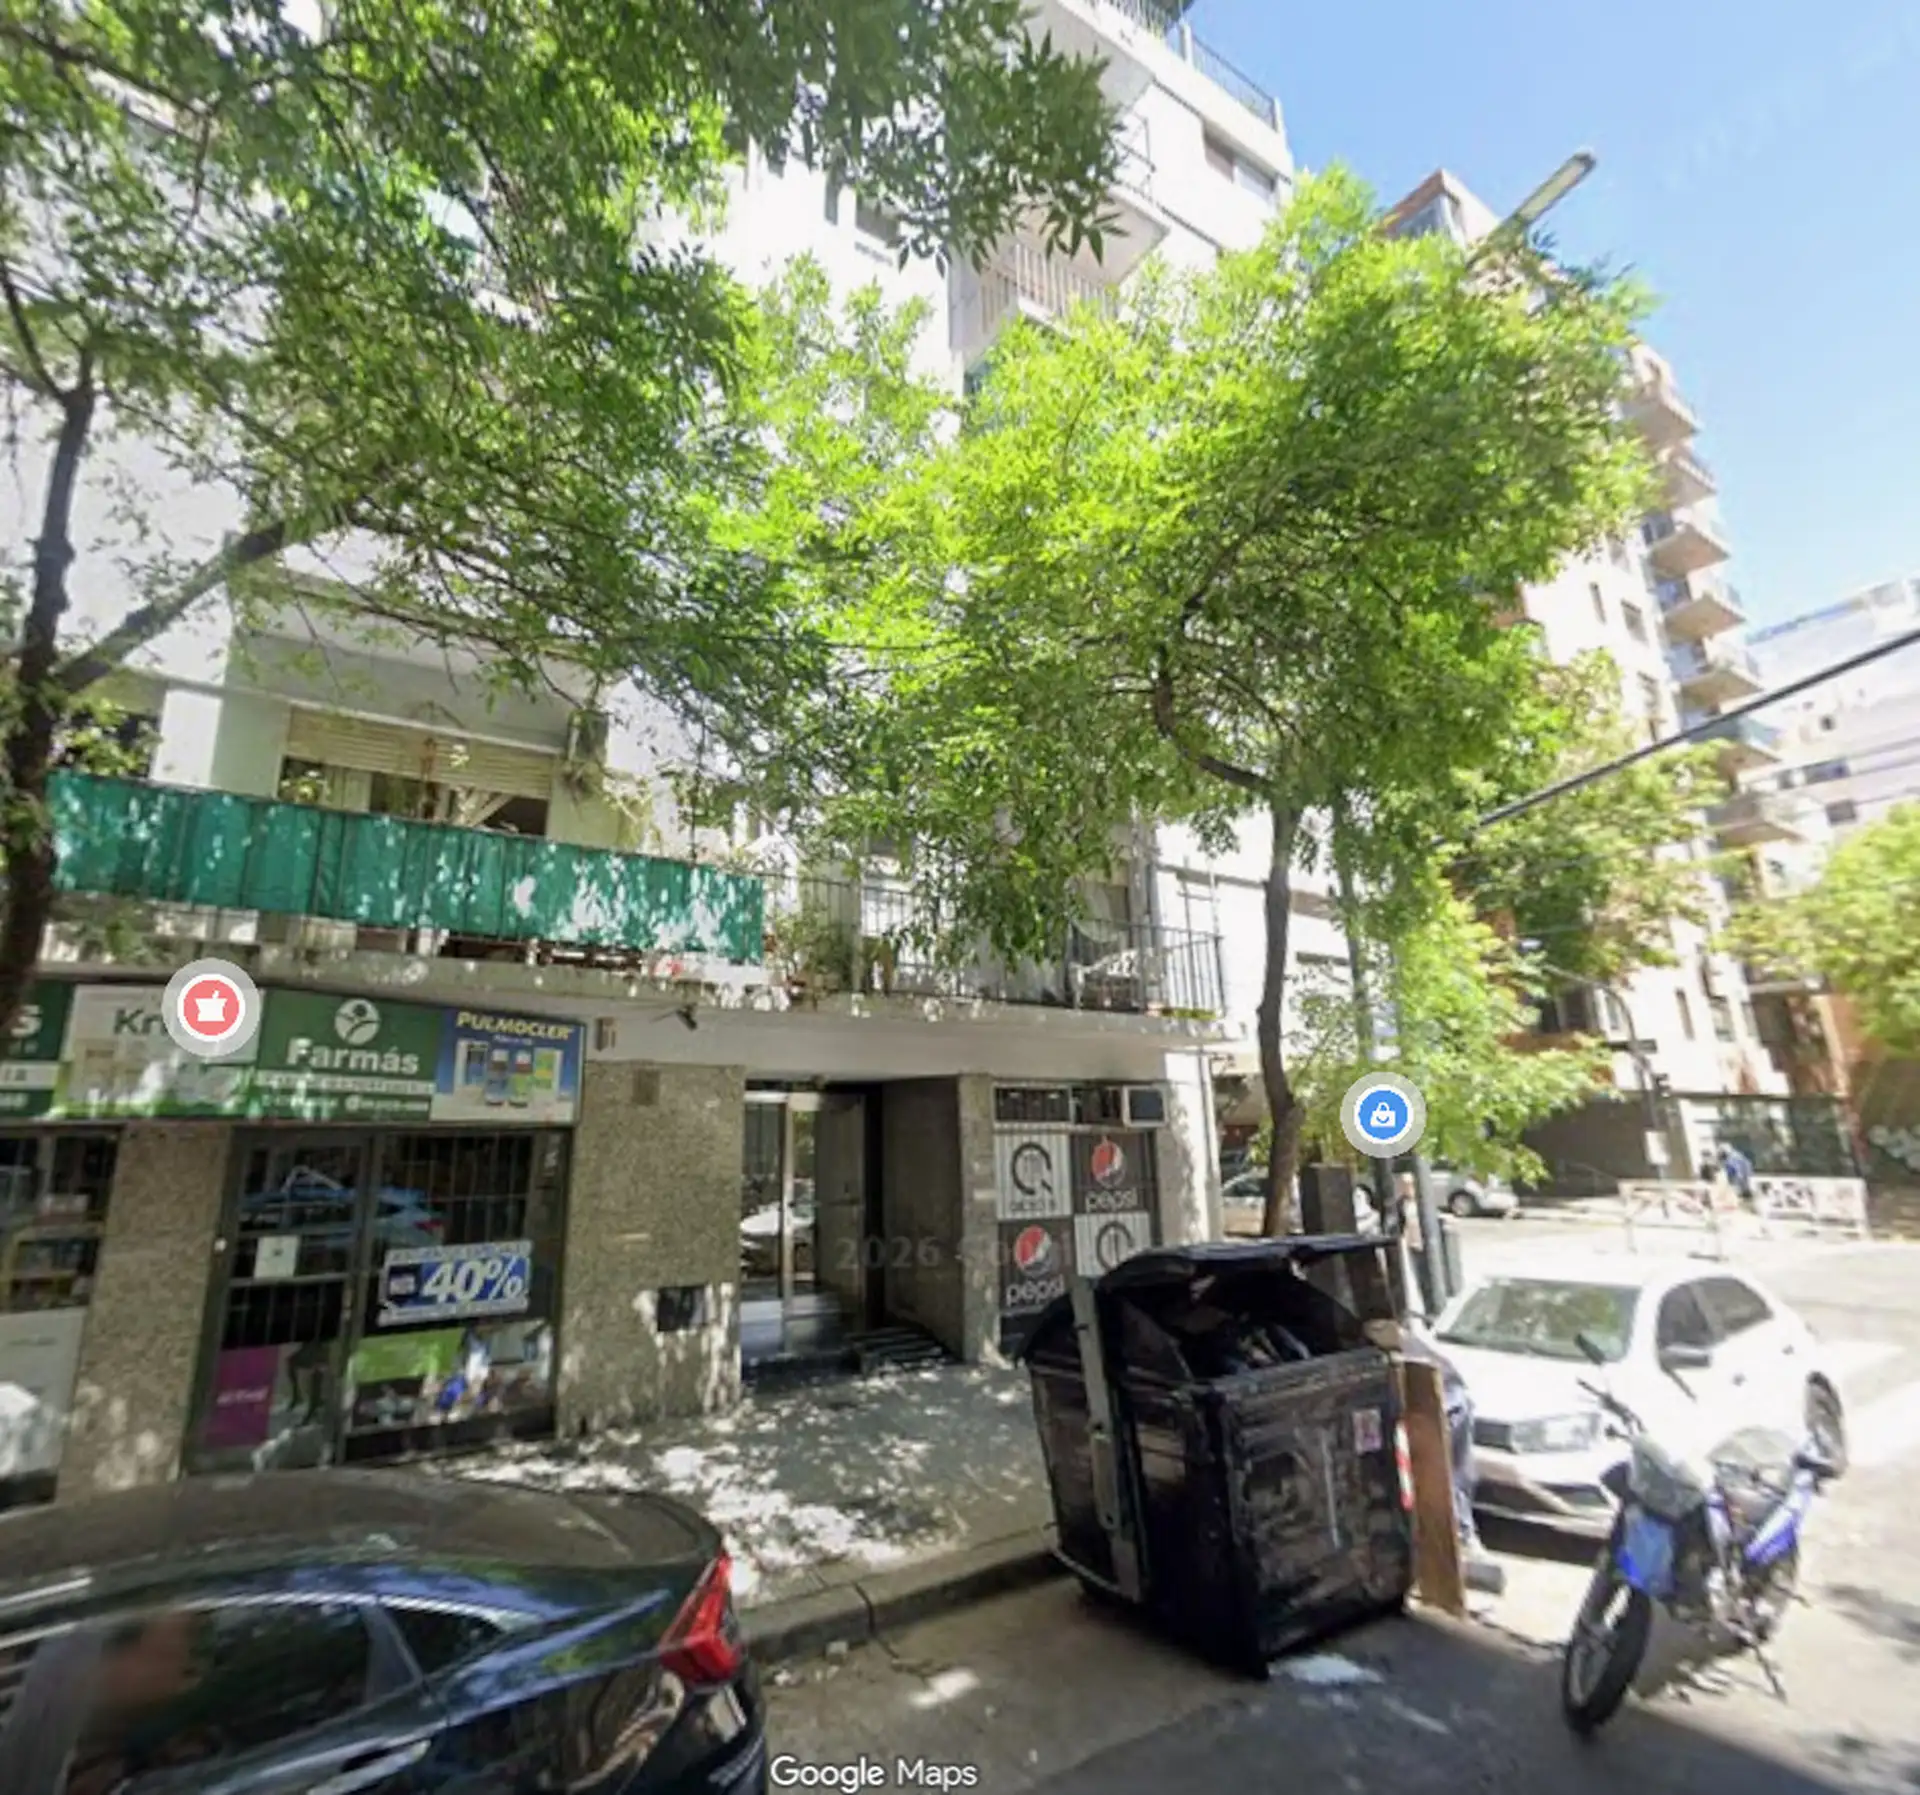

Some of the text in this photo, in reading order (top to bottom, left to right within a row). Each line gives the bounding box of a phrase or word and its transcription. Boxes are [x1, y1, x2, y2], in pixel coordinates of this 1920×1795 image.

[286, 1037, 419, 1075] Farmás
[1085, 1187, 1138, 1213] pepsi
[421, 1255, 525, 1304] 40%
[1005, 1274, 1065, 1308] pepsi
